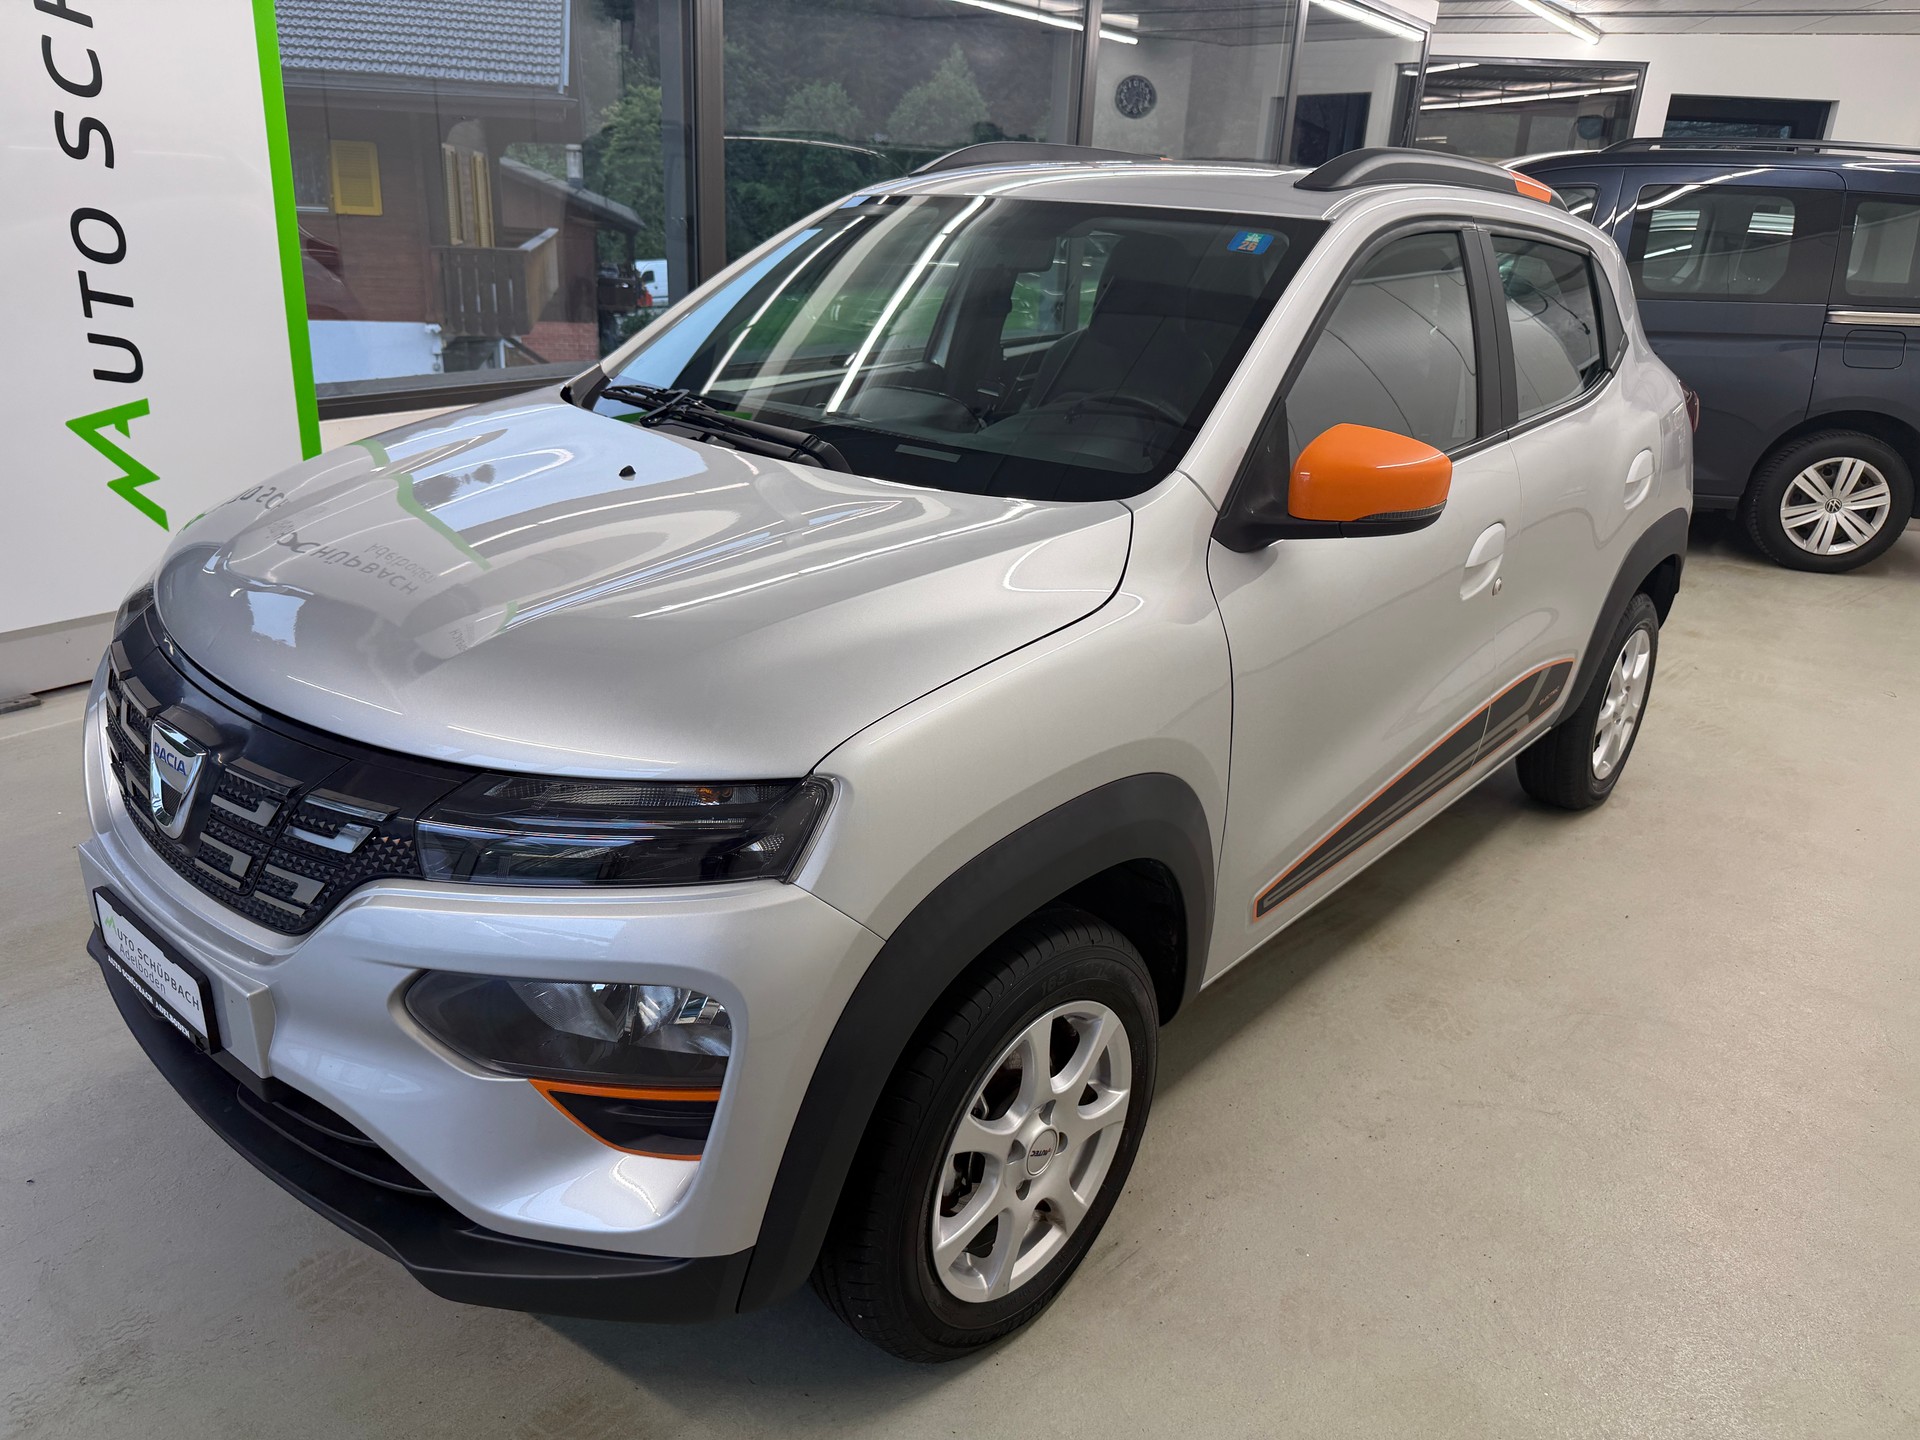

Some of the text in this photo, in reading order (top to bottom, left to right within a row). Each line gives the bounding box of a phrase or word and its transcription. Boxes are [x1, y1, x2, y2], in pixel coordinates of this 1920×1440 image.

[153, 741, 187, 777] DACIA
[119, 943, 167, 995] Adelboden
[137, 947, 200, 1012] SCHÜPBACH
[155, 1001, 191, 1039] ADELBODEN
